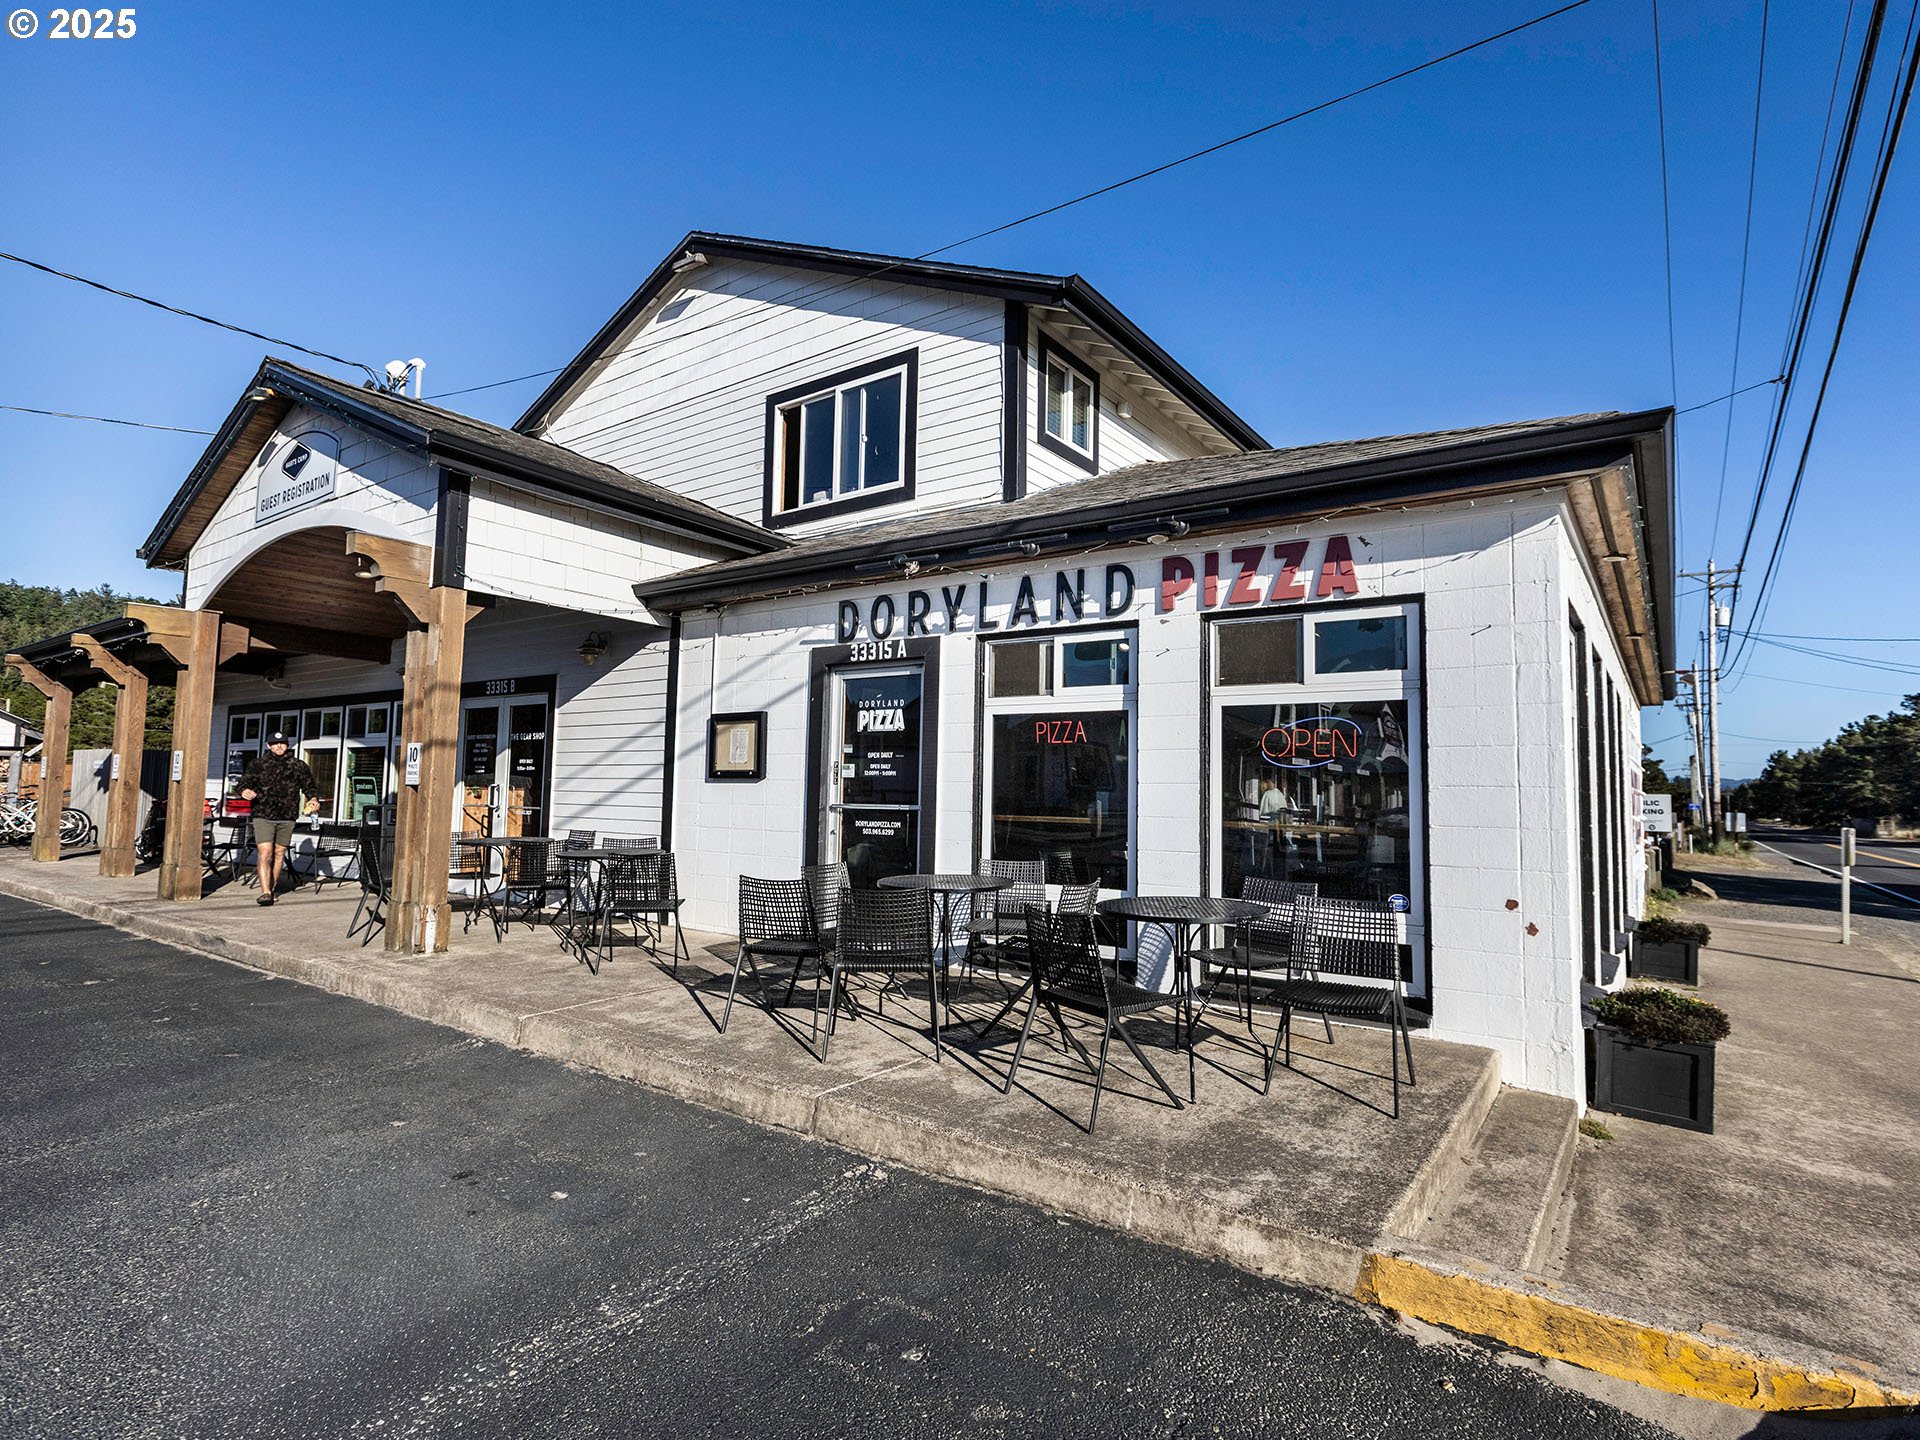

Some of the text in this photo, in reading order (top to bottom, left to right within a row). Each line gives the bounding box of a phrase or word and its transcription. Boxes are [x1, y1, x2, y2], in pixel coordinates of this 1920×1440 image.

[261, 473, 330, 512] GUEST REGISTRATION
[838, 535, 1360, 643] DORYLAND PIZZA
[850, 638, 907, 661] 33315 A
[486, 680, 508, 694] 33315
[858, 699, 905, 708] DORYLAND
[857, 708, 905, 732] PIZZA
[532, 732, 545, 740] SHOP
[1035, 720, 1087, 744] PIZZA
[1262, 728, 1357, 758] OPEN
[410, 746, 418, 762] 10
[855, 820, 901, 828] DORYLANDPIZZA.COM
